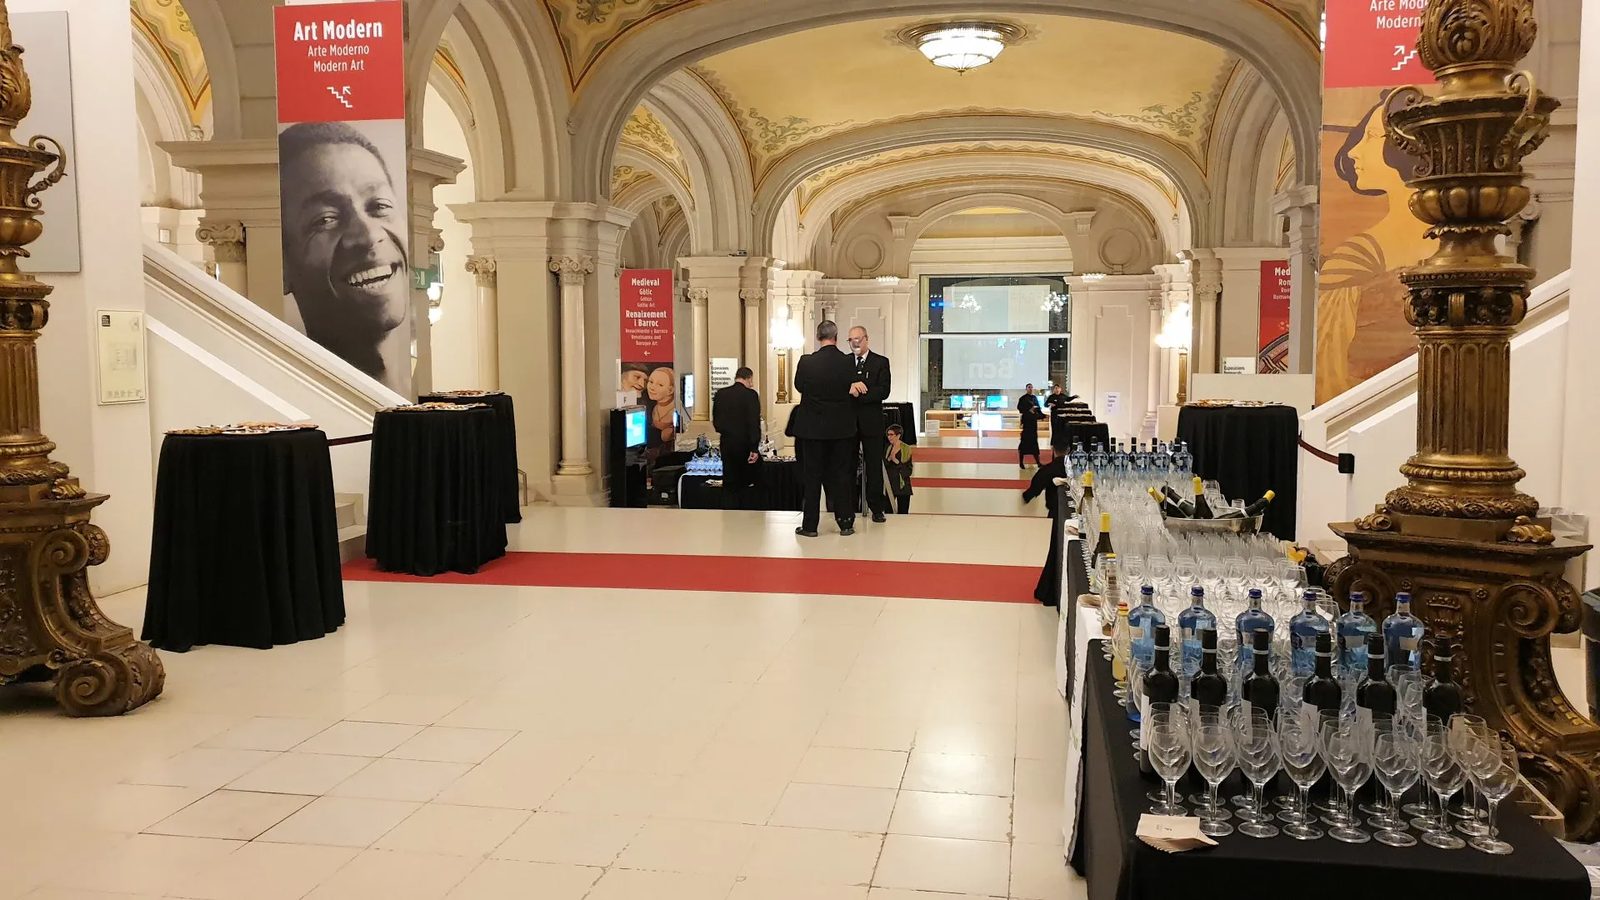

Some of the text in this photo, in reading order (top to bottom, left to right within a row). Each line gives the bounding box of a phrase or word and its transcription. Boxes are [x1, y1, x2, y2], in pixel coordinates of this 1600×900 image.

[1369, 0, 1396, 12] Arte
[1376, 15, 1421, 29] Modern
[293, 19, 383, 41] Art Modern
[307, 44, 370, 57] Arte Moderno
[313, 59, 365, 72] Modern Art
[631, 277, 660, 286] Medieval
[625, 309, 667, 318] Renaixement
[638, 318, 659, 327] Barroc
